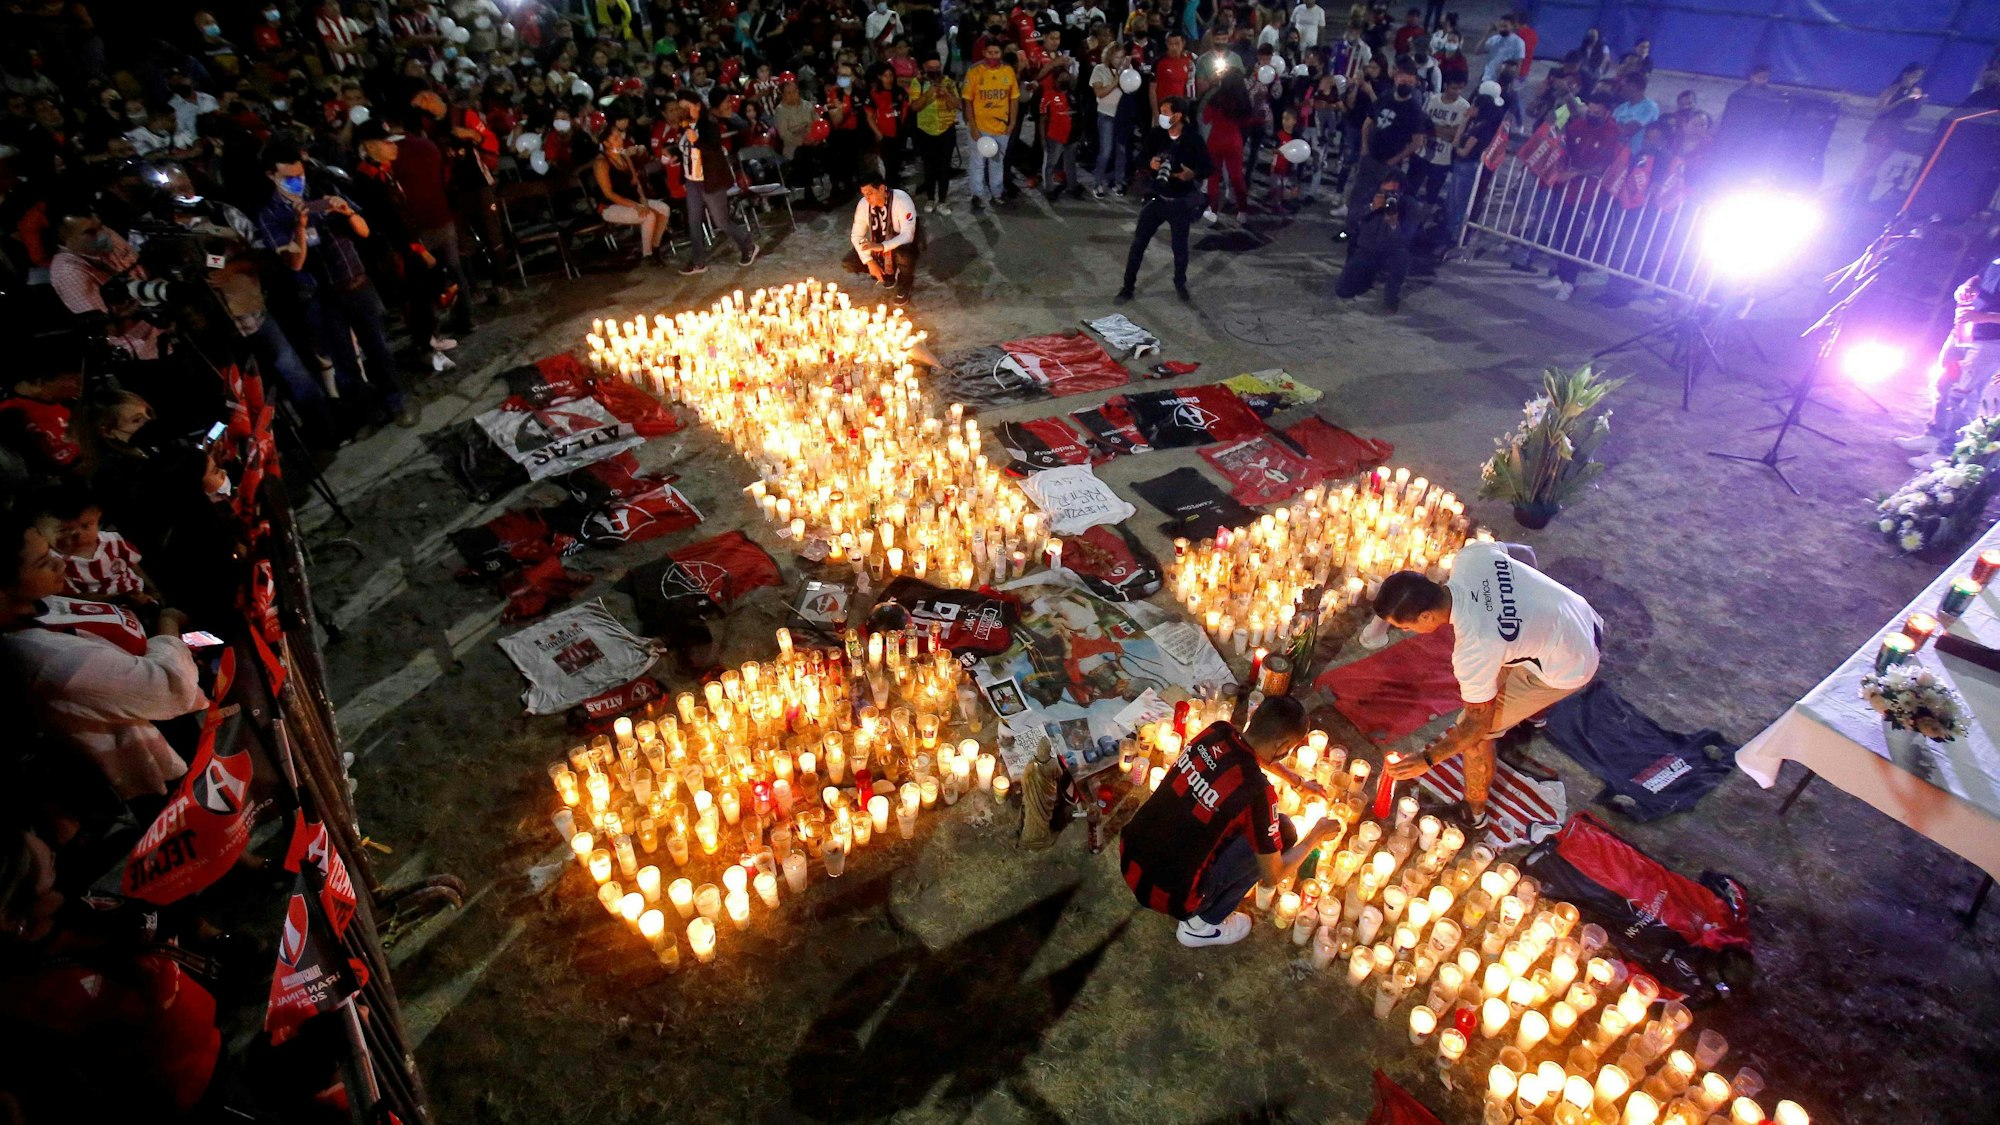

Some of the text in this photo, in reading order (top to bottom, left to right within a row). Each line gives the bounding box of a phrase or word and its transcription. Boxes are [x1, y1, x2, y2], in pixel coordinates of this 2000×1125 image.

[532, 424, 620, 466] ATLAS
[1495, 560, 1522, 642] Corona
[586, 695, 623, 713] ATLAS
